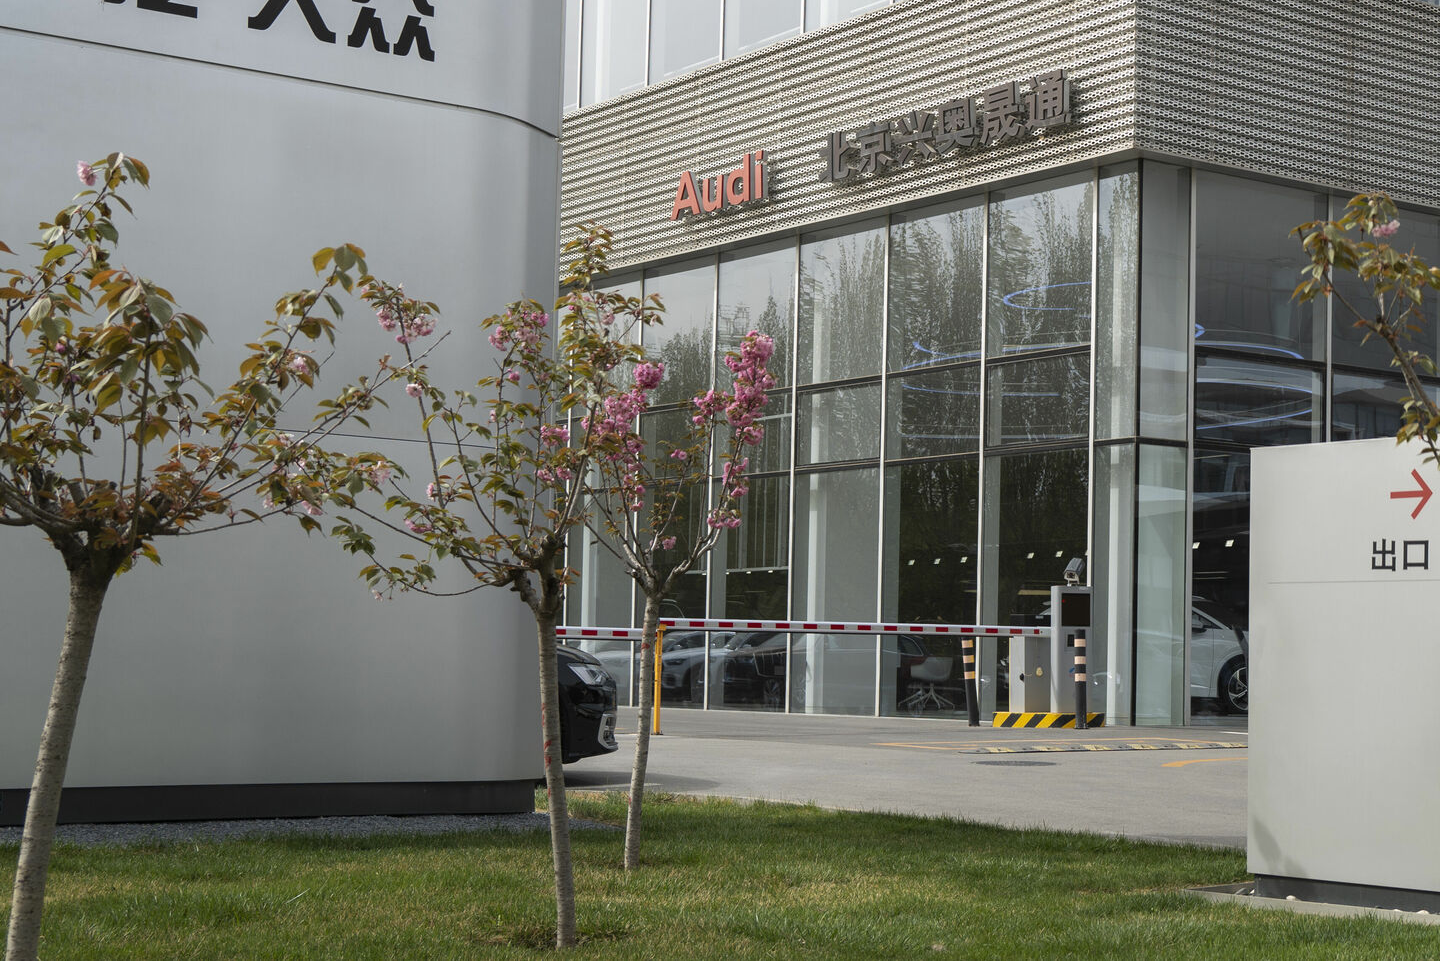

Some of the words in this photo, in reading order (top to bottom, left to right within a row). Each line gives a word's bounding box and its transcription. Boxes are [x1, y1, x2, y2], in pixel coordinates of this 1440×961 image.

[669, 148, 769, 221] Audi
[819, 69, 1074, 184] 北京兴奥晟通
[1371, 538, 1430, 572] 出口
